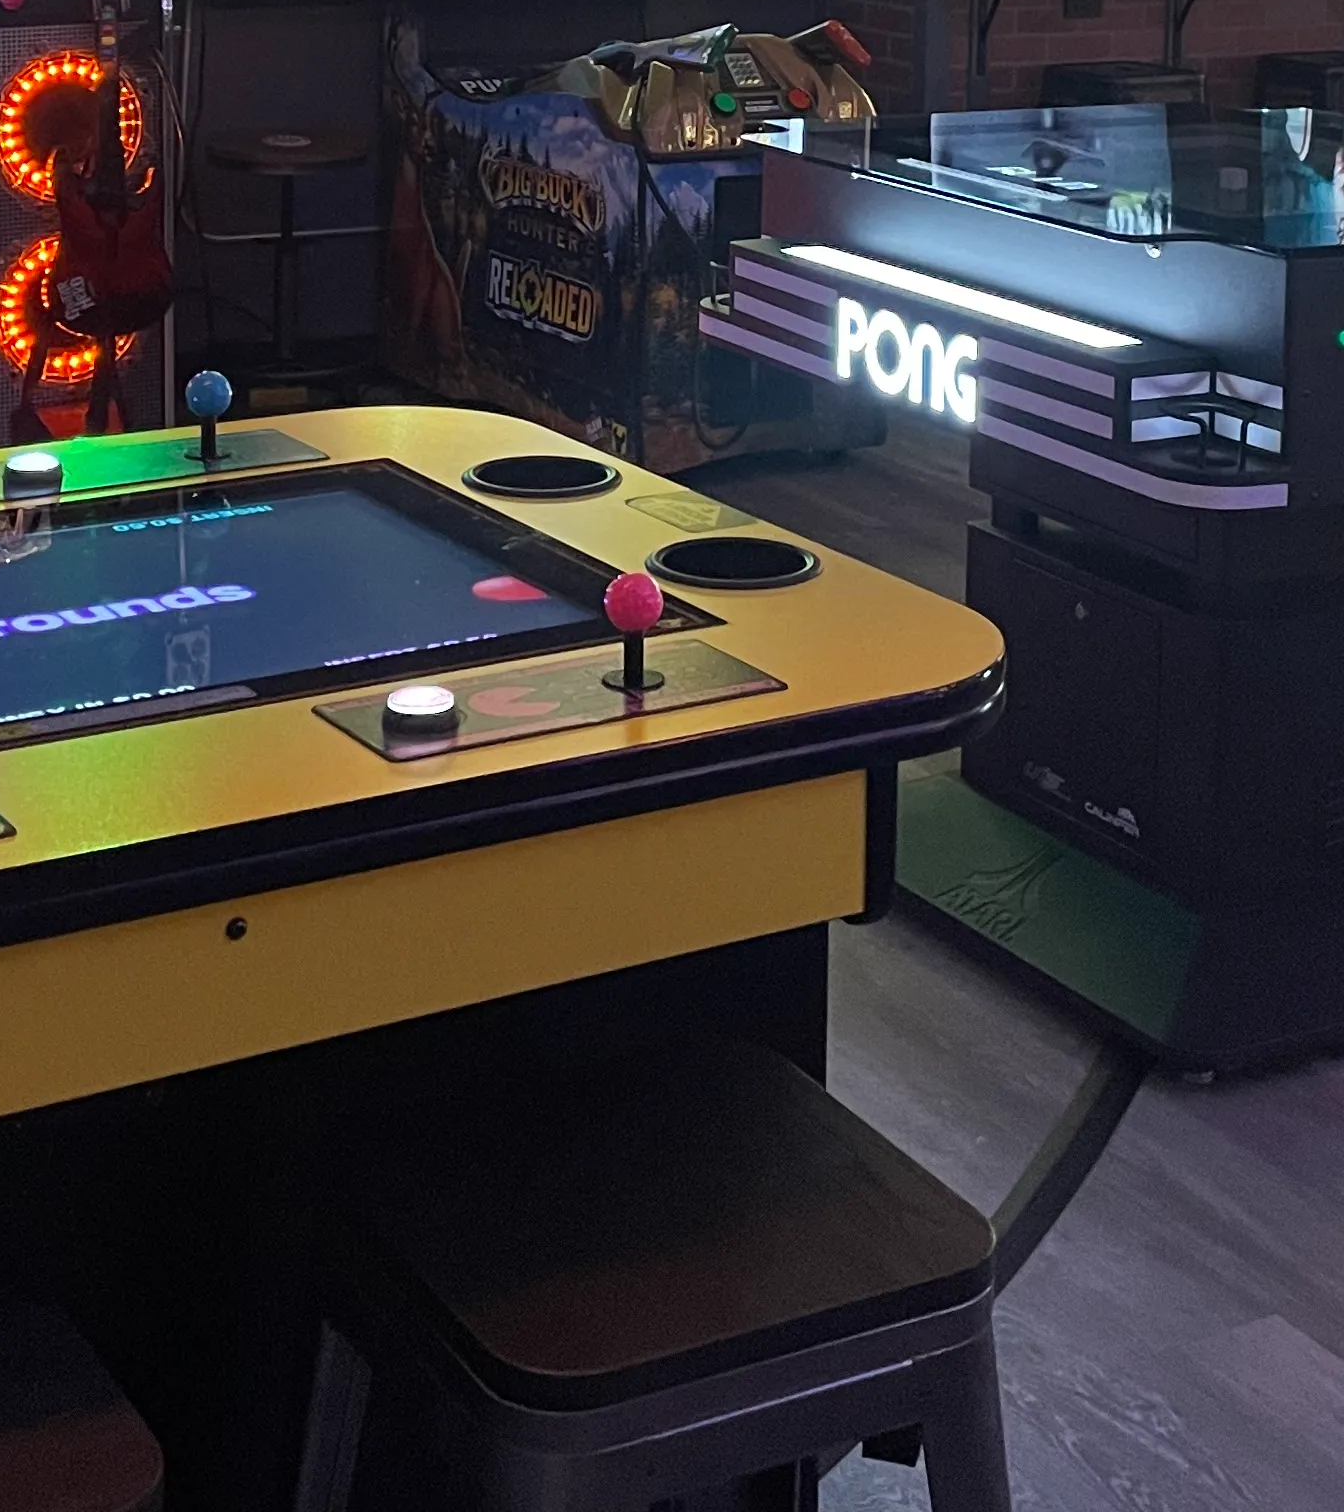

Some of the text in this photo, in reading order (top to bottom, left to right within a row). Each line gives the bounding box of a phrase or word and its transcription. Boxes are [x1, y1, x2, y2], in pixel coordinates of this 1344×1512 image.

[494, 162, 591, 226] BIG BUCK
[507, 214, 580, 253] HUNTER
[489, 257, 593, 334] RELOADED
[836, 296, 979, 424] PONG
